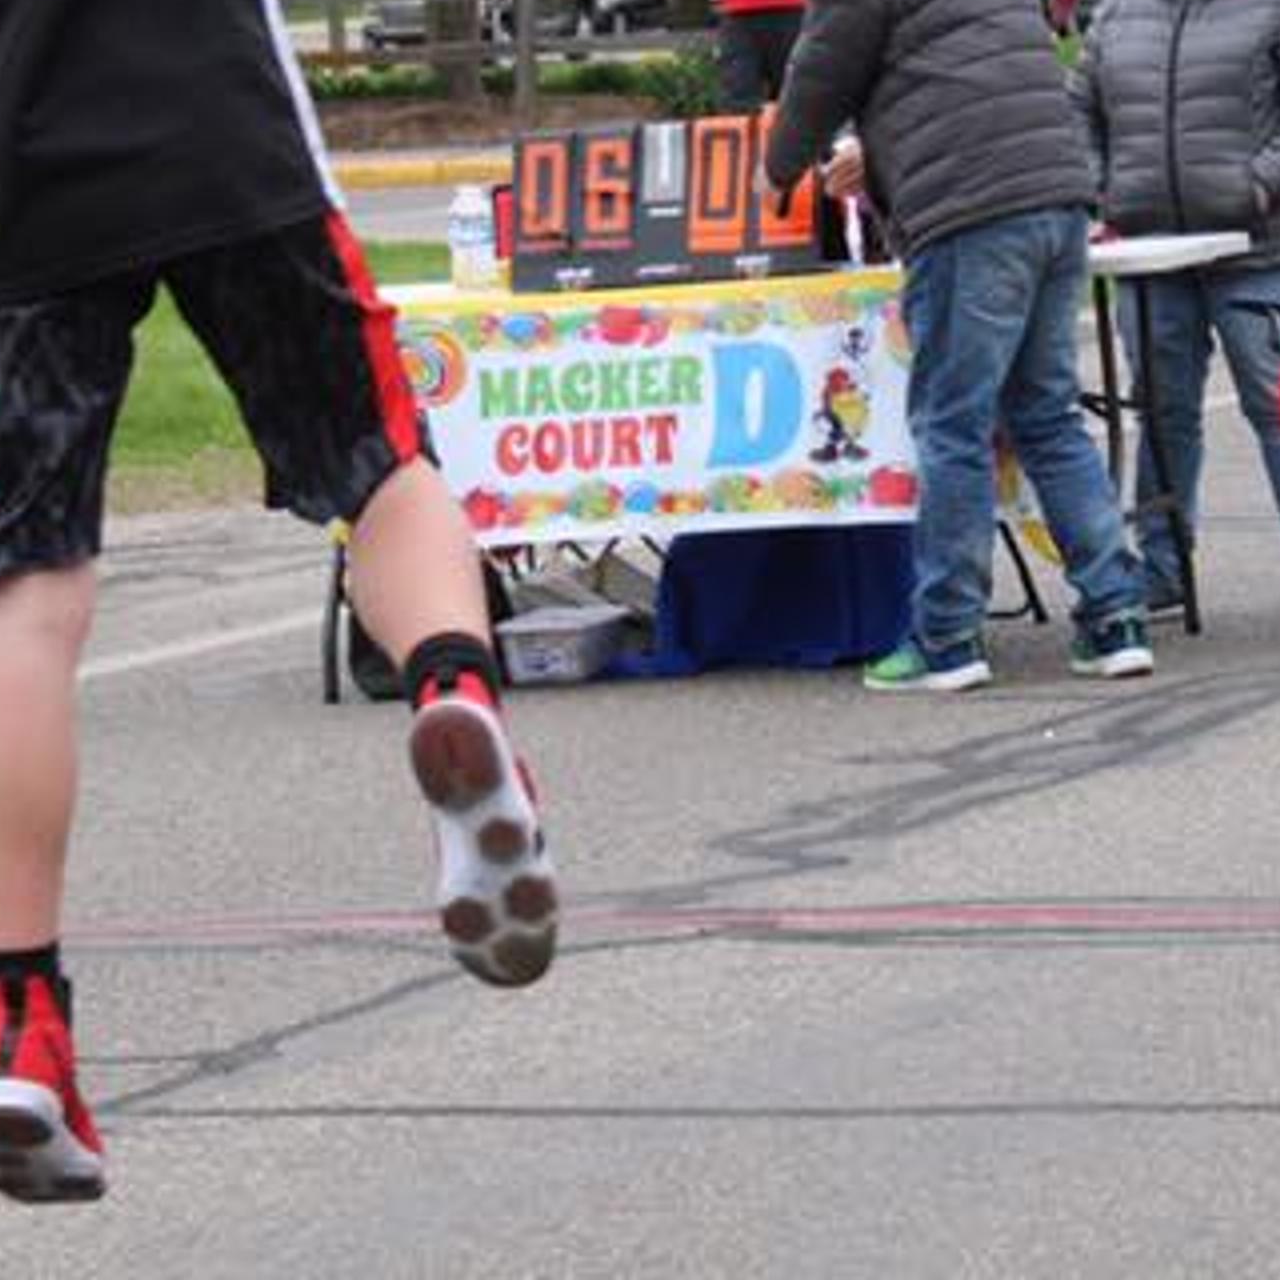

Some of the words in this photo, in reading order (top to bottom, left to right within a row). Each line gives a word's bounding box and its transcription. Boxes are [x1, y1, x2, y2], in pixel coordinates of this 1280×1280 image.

[478, 355, 703, 419] MACKER
[495, 414, 679, 477] COURT
[705, 341, 803, 469] D
